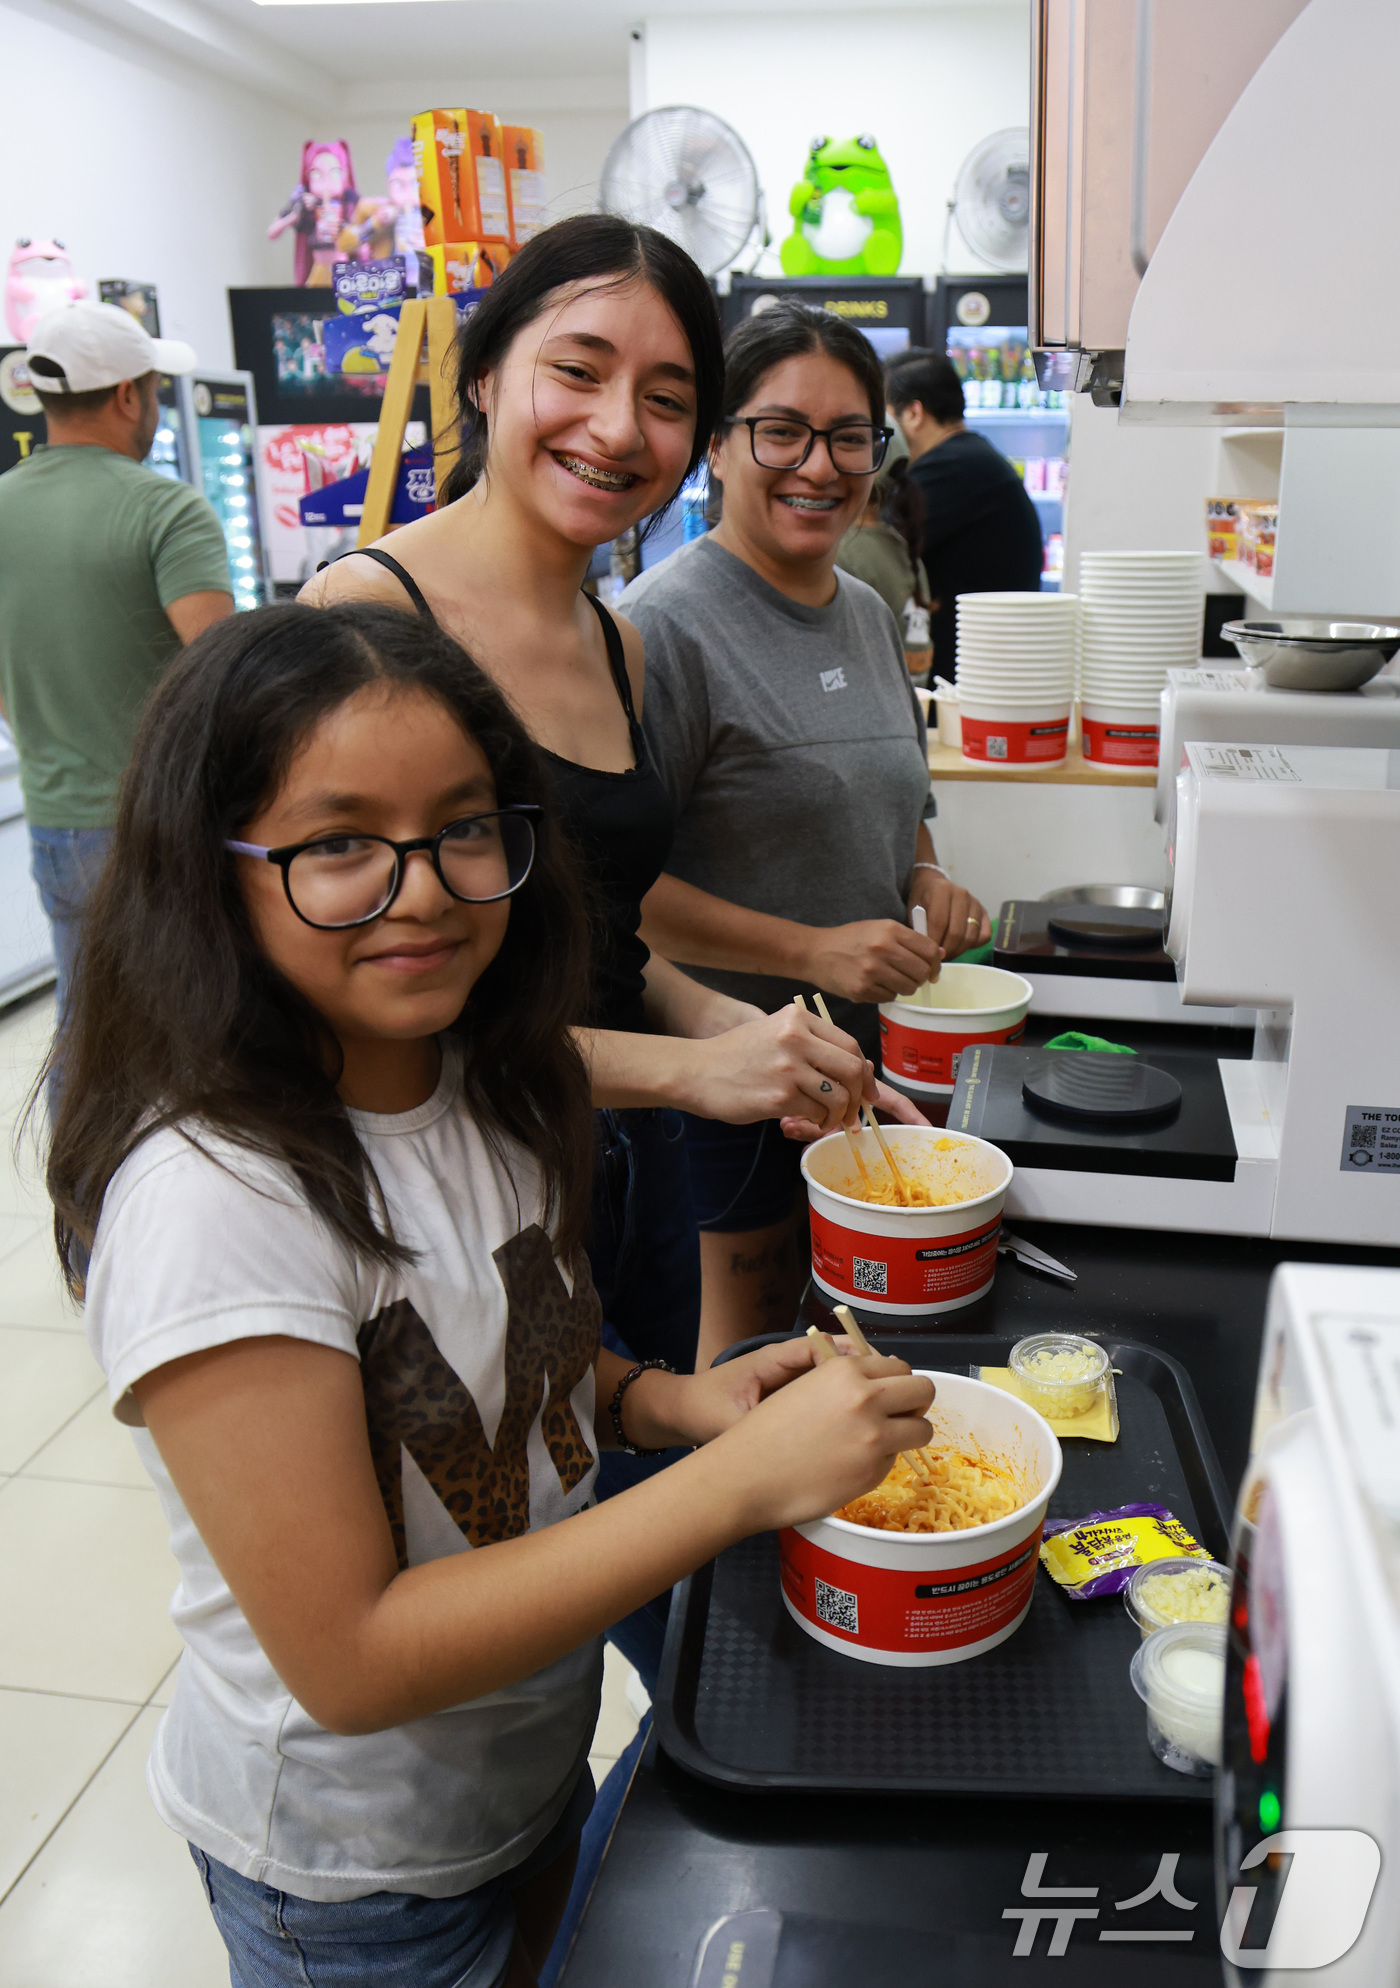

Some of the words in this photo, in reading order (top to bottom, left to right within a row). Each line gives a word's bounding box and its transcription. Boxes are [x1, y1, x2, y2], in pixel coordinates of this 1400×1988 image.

[1362, 1113, 1382, 1121] THE
[1069, 1533, 1132, 1557] 불닭볶음면
[932, 1585, 956, 1595] 반드시
